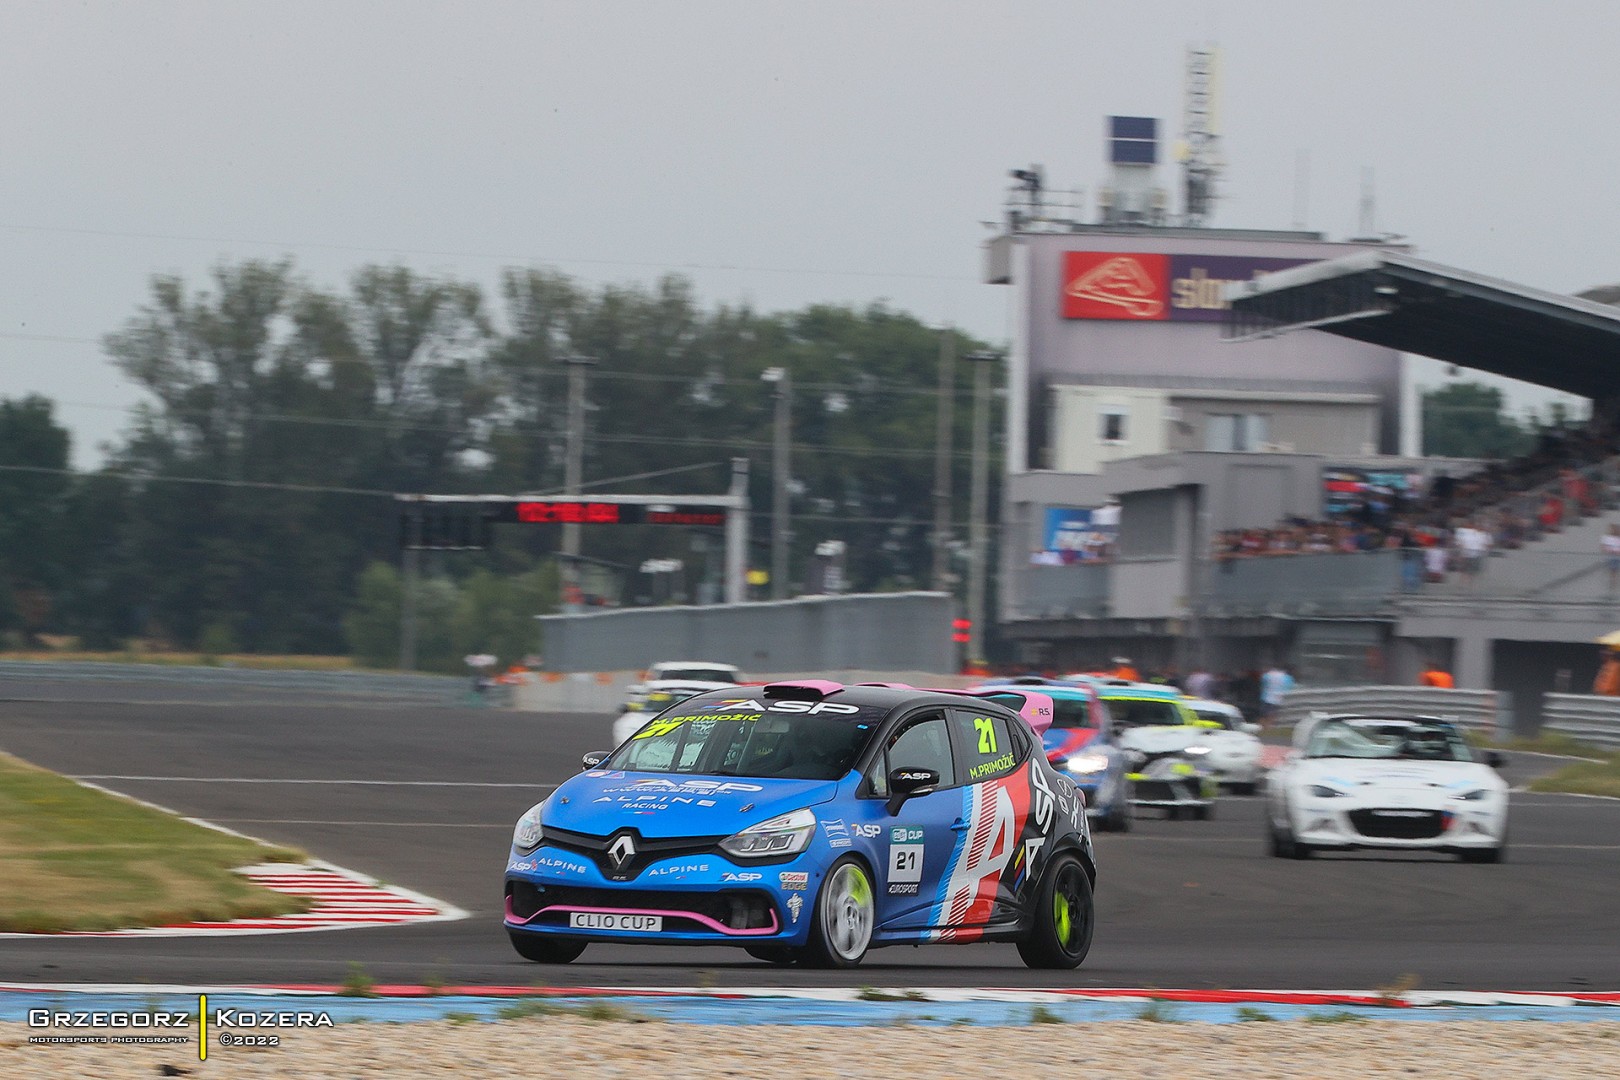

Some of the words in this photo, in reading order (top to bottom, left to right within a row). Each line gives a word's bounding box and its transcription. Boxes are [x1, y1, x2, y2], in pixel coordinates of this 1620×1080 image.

[716, 699, 860, 715] ASP
[973, 717, 997, 754] 21
[902, 772, 931, 780] ASP
[632, 779, 763, 792] ASP
[592, 795, 717, 807] ALPINE
[856, 824, 881, 838] ASP
[908, 830, 924, 840] CUP
[538, 857, 587, 874] ALPINE
[896, 851, 916, 870] 21
[648, 864, 710, 877] ALPINE
[724, 872, 763, 882] ASP
[575, 914, 615, 928] CLIO
[620, 916, 656, 930] CUP
